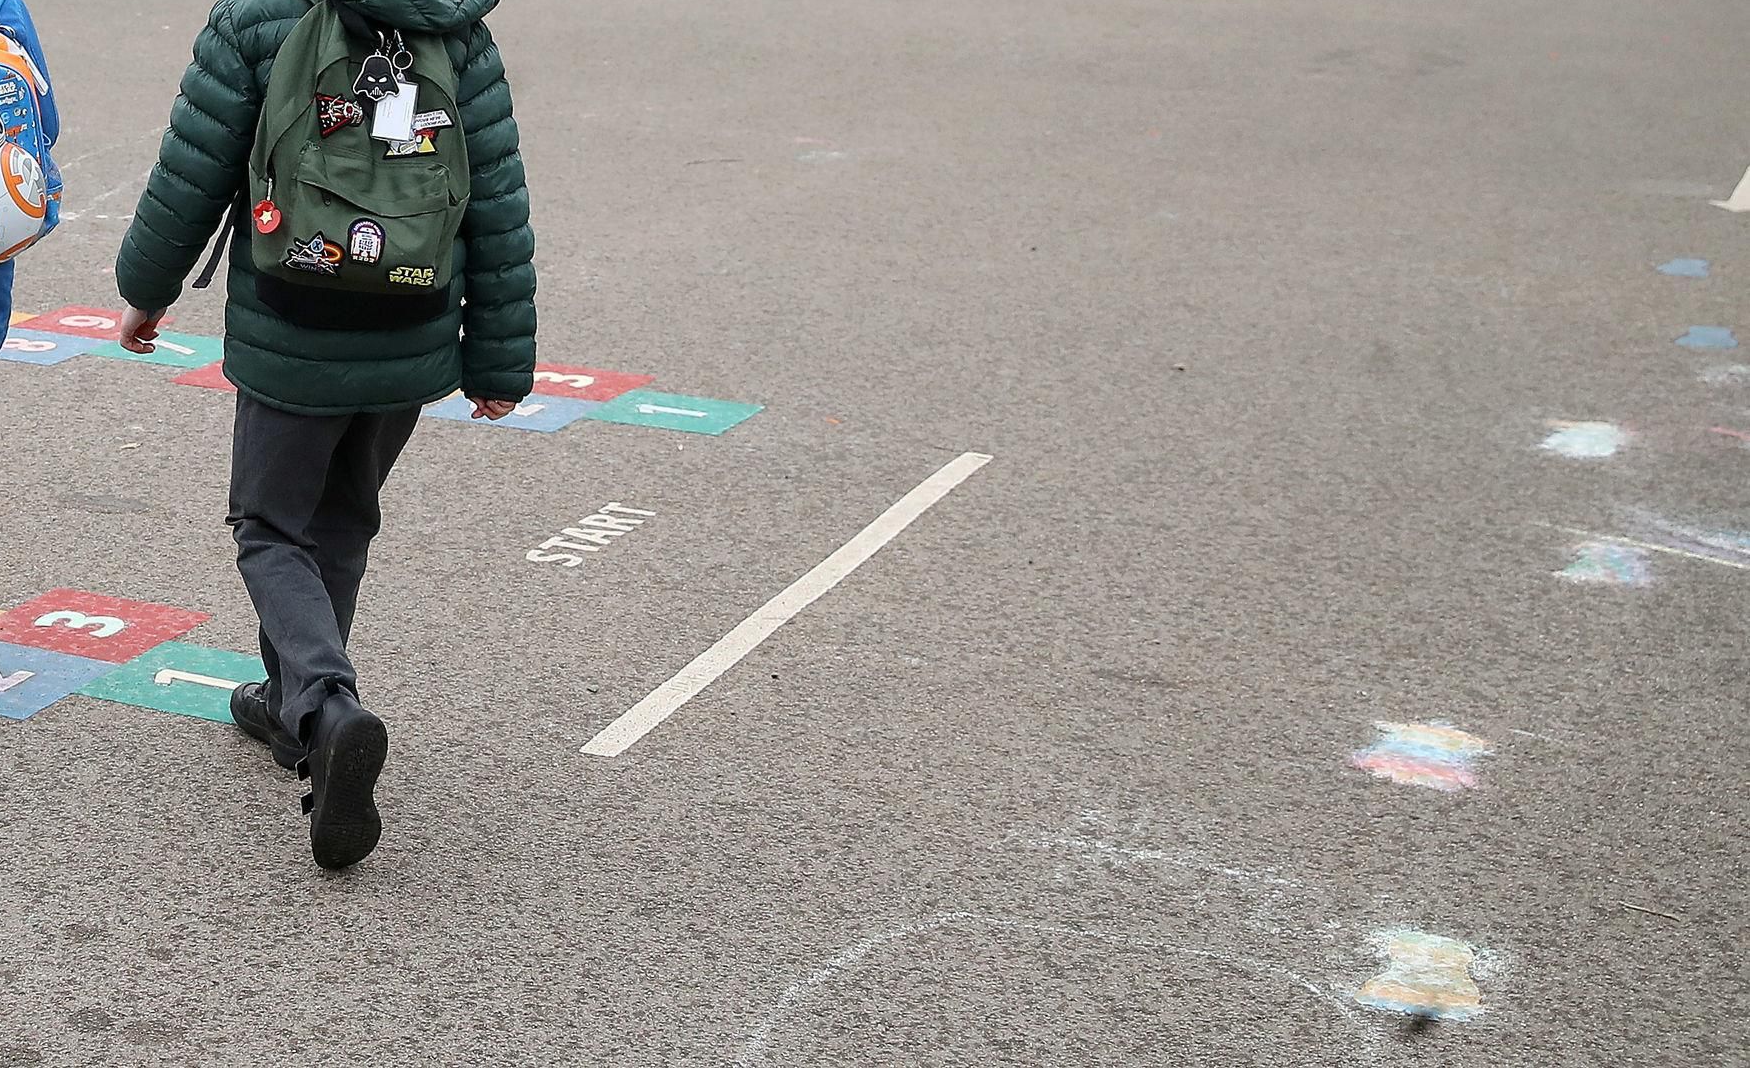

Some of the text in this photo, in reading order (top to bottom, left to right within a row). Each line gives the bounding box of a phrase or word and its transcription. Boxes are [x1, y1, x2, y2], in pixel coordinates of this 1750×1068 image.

[389, 266, 435, 278] STAR
[389, 274, 434, 286] WARS
[58, 314, 117, 330] 9
[4, 337, 57, 352] 8
[534, 371, 595, 388] 3
[635, 404, 708, 418] 1
[526, 501, 656, 568] START
[33, 609, 126, 639] 3
[153, 668, 242, 691] 1
